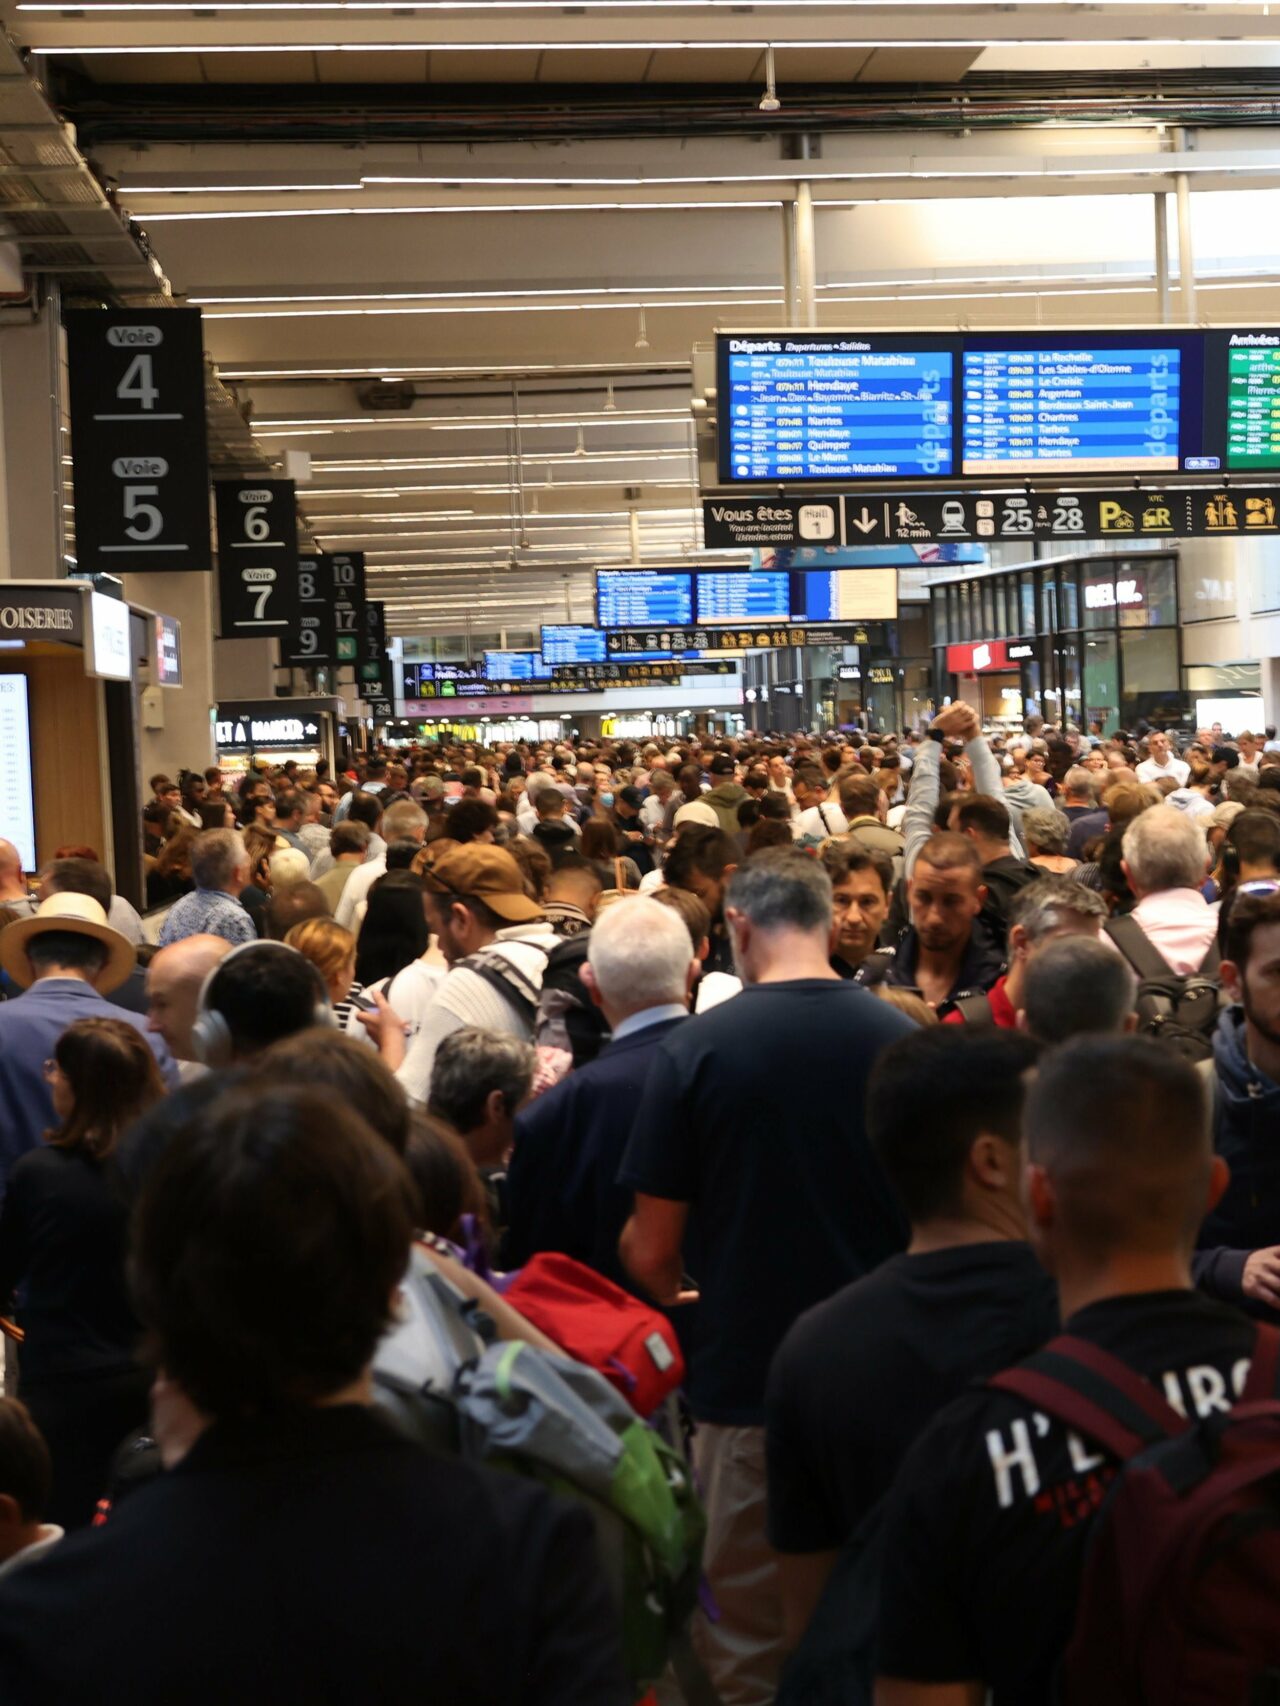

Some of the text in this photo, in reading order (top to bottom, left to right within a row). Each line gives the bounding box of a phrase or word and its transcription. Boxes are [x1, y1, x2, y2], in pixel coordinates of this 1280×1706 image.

[113, 329, 155, 346] Voie
[1229, 334, 1280, 346] Arrivées
[729, 341, 781, 354] Départs
[785, 342, 833, 353] Departures
[807, 356, 860, 367] Toulouse
[861, 355, 915, 366] Matabiau
[1038, 353, 1093, 362] La Rochelle
[770, 369, 813, 378] Toulouse
[814, 369, 859, 377] Matabiau
[1038, 364, 1132, 374] Les Sables-d'Olonne
[116, 354, 160, 410] 4
[807, 380, 859, 392] Hendaye
[1038, 377, 1084, 386] Le Croisic
[813, 392, 853, 403] Bayonne
[1038, 389, 1082, 400] Argentan
[807, 404, 843, 414] Nantes
[1038, 401, 1082, 410] Bordeaux
[1083, 400, 1133, 410] Saint-Jean
[807, 416, 843, 426] Nantes
[1038, 412, 1079, 422] Chartres
[807, 428, 850, 440] Hendaye
[1038, 424, 1070, 434] Tarbes
[807, 441, 851, 452] Quimper
[1038, 436, 1080, 447] Hendaye
[808, 452, 848, 462] Le Mans
[1038, 449, 1072, 458] Nantes
[120, 460, 161, 476] Voie
[808, 464, 852, 474] Toulouse
[852, 463, 897, 473] Matabiau
[242, 492, 269, 502] Voie
[123, 485, 163, 541] 5
[711, 505, 793, 522] Vous êtes
[805, 508, 828, 519] Hall
[1037, 505, 1048, 519] à
[1100, 501, 1121, 528] P
[243, 506, 271, 542] 6
[1001, 509, 1033, 531] 25
[1052, 508, 1084, 530] 28
[729, 524, 746, 532] You
[811, 521, 822, 535] 1
[910, 528, 931, 538] min
[246, 570, 274, 581] Voie
[333, 565, 355, 584] 10
[299, 573, 316, 599] 8
[246, 585, 273, 620] 7
[335, 611, 356, 630] 17
[300, 630, 318, 655] 9
[339, 642, 352, 657] N
[376, 703, 392, 717] 24
[235, 722, 246, 742] A
